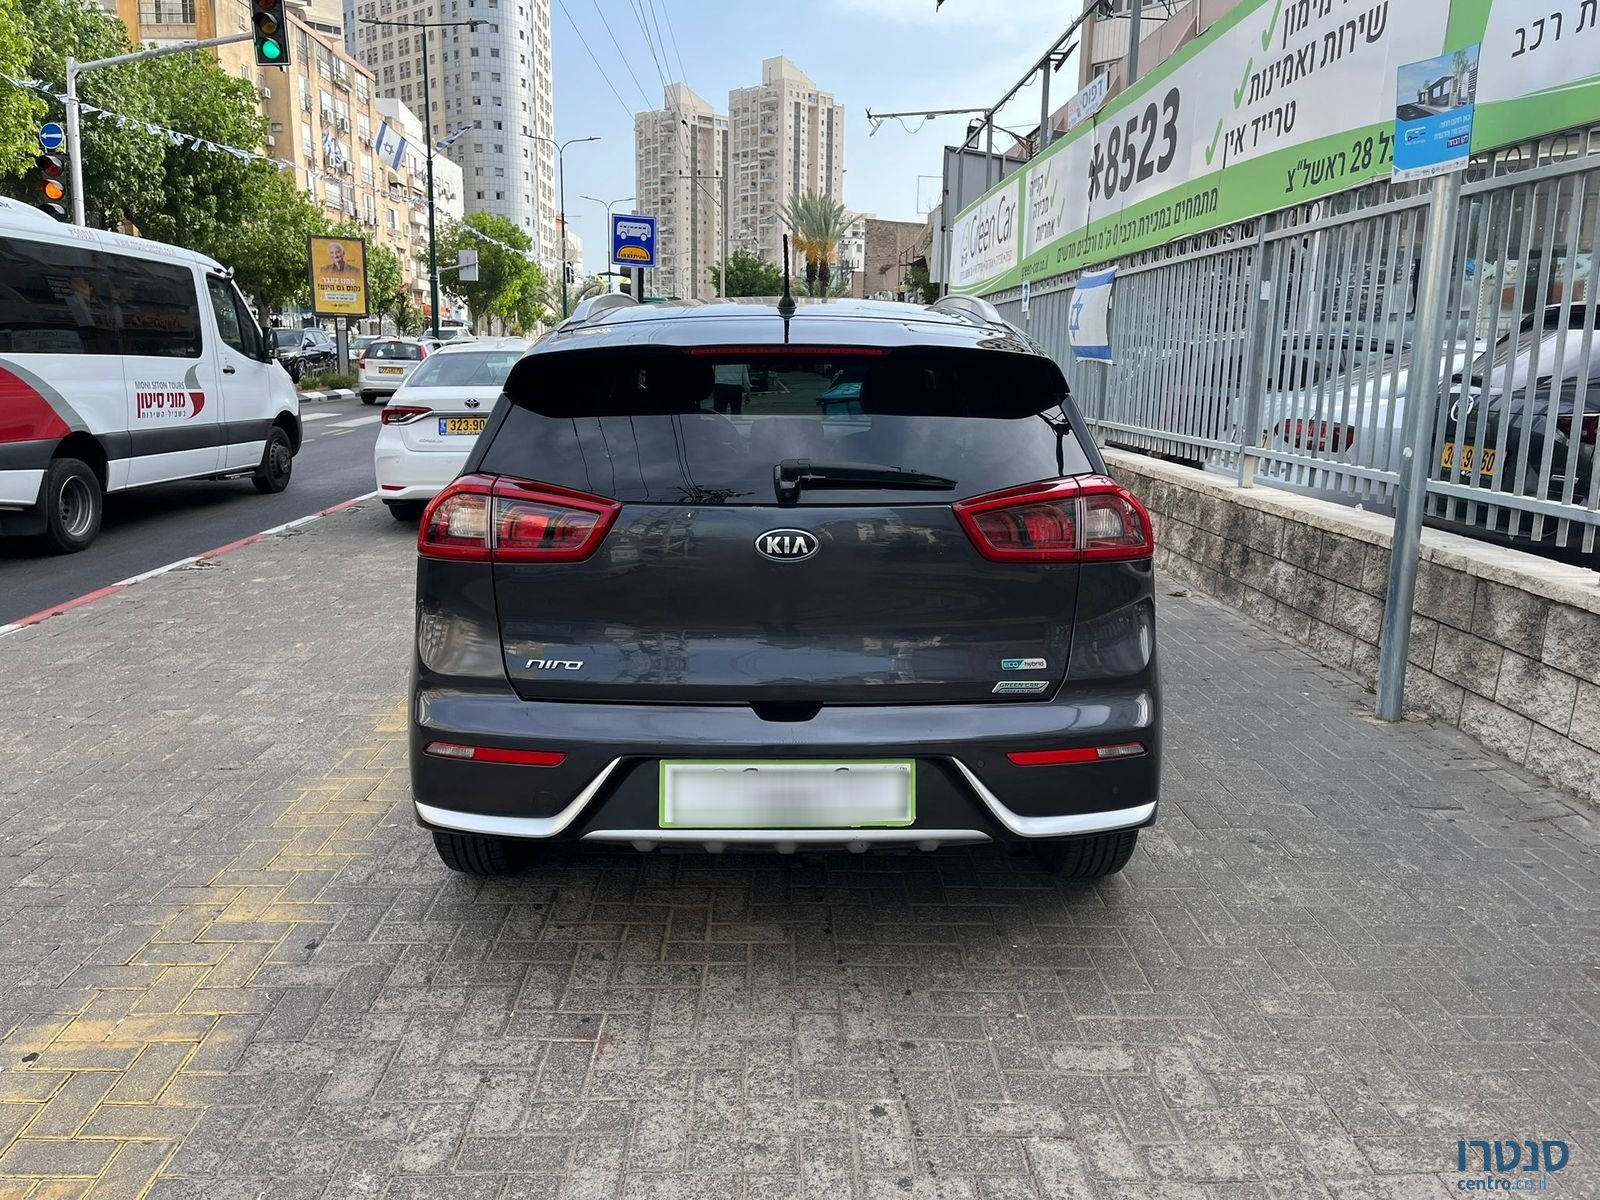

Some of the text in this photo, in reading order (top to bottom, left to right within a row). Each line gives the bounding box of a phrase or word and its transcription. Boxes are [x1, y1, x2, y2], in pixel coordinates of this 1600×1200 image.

[1511, 11, 1562, 58] רכב
[1248, 1, 1389, 106] שירות ואמינות
[1082, 79, 1103, 109] דפוס
[1222, 100, 1297, 169] טרייד אין
[1350, 136, 1373, 173] 28
[1137, 206, 1171, 238] במכירת
[1173, 187, 1219, 224] מתמחים
[135, 381, 185, 389] MONI SITON TOURS
[136, 392, 186, 418] מוני סיטון
[766, 536, 809, 554] KIA
